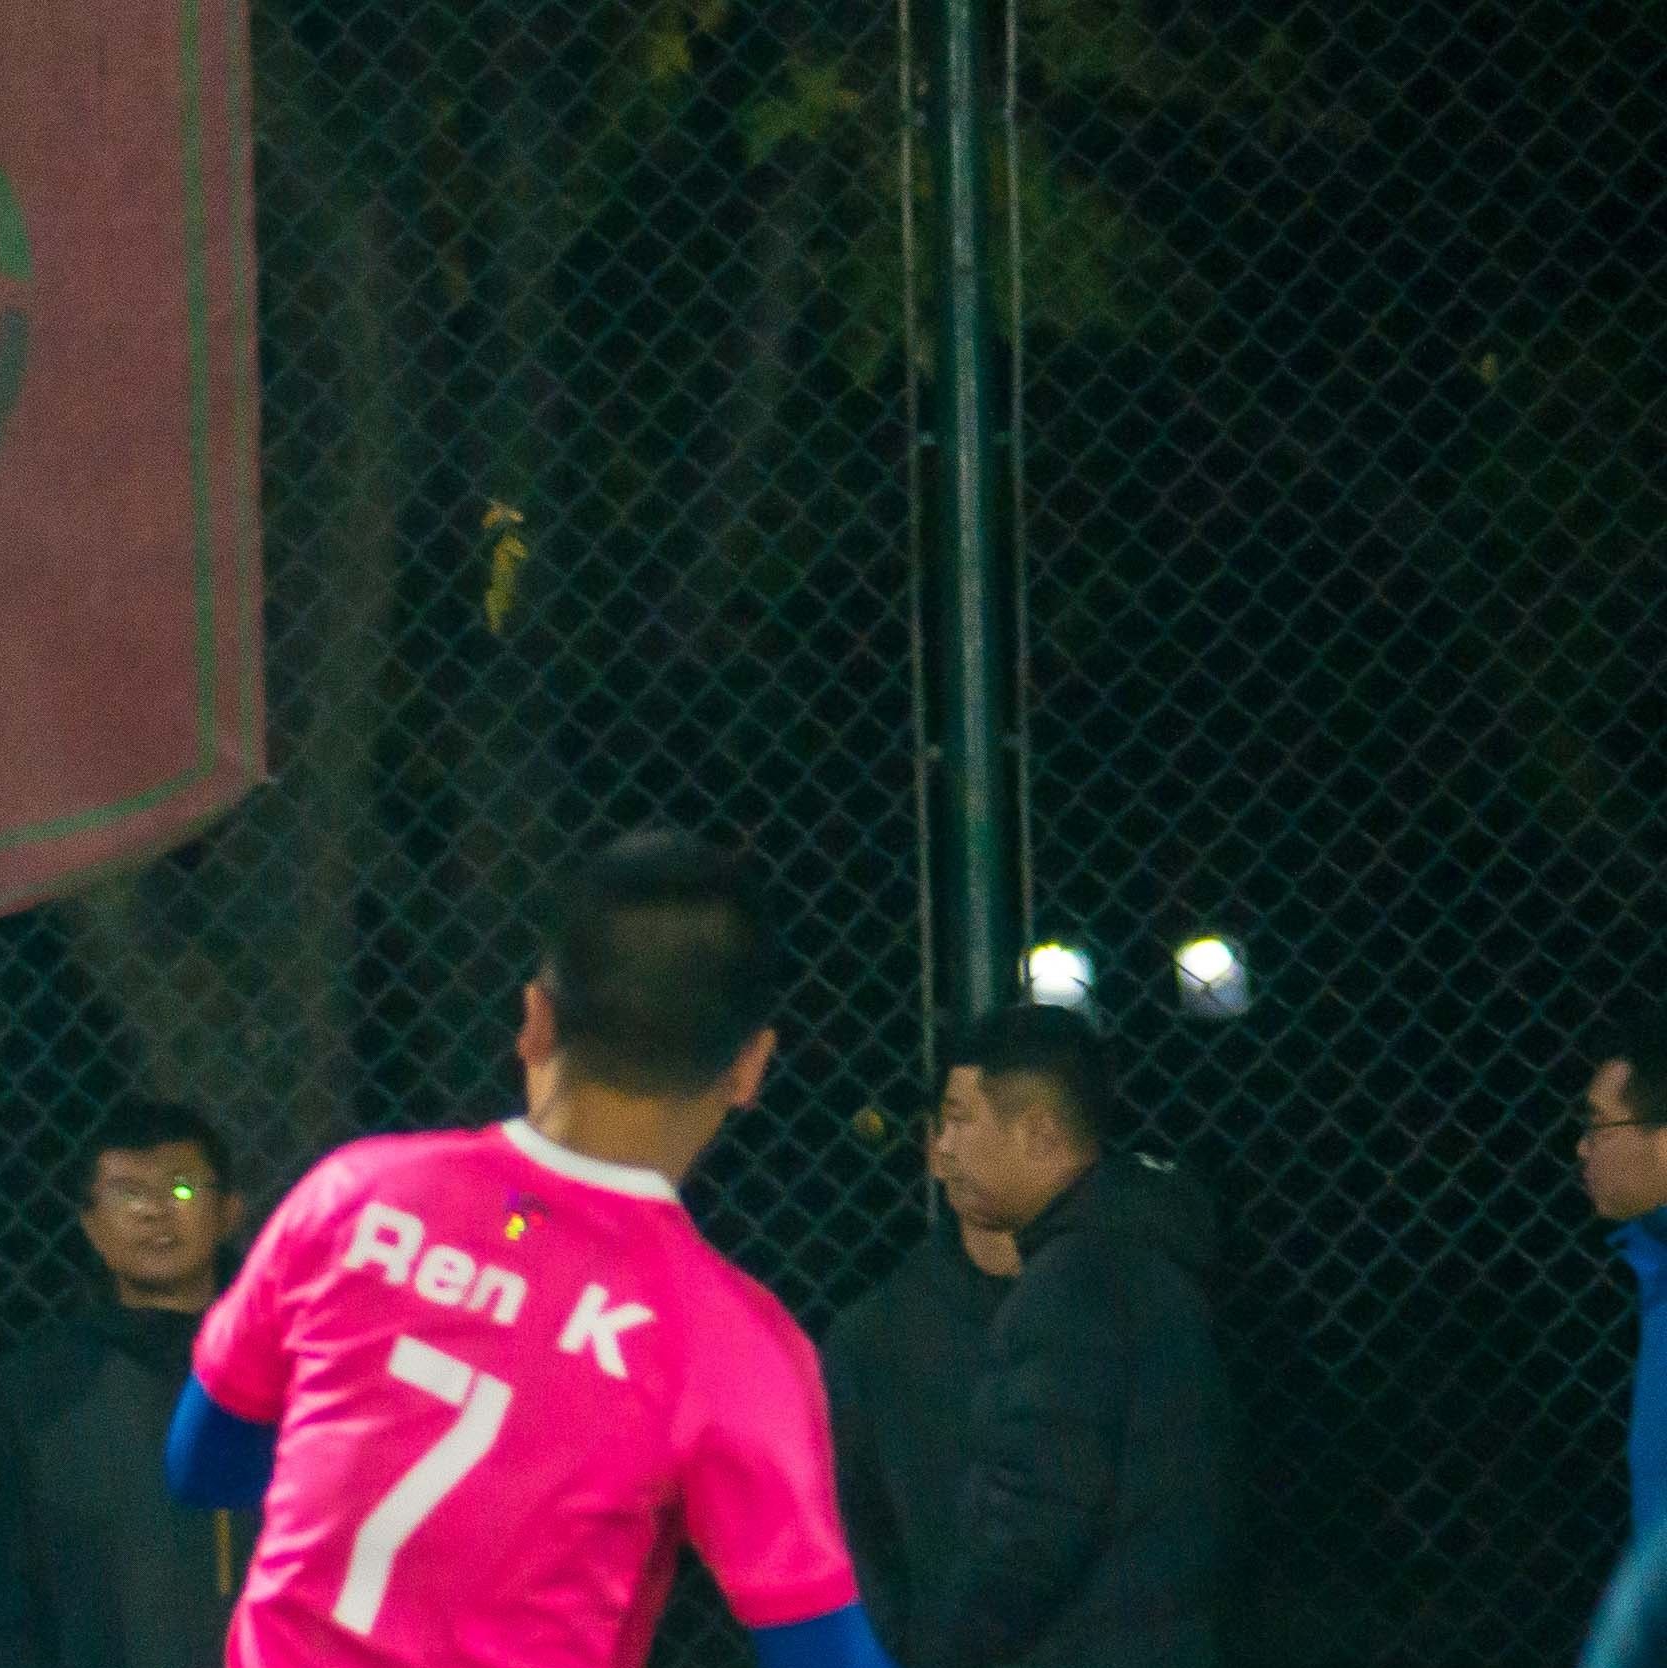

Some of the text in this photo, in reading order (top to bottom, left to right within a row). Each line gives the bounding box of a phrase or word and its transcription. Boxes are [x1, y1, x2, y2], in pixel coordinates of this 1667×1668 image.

[343, 1202, 655, 1379] Ren K
[332, 1334, 514, 1636] 7
